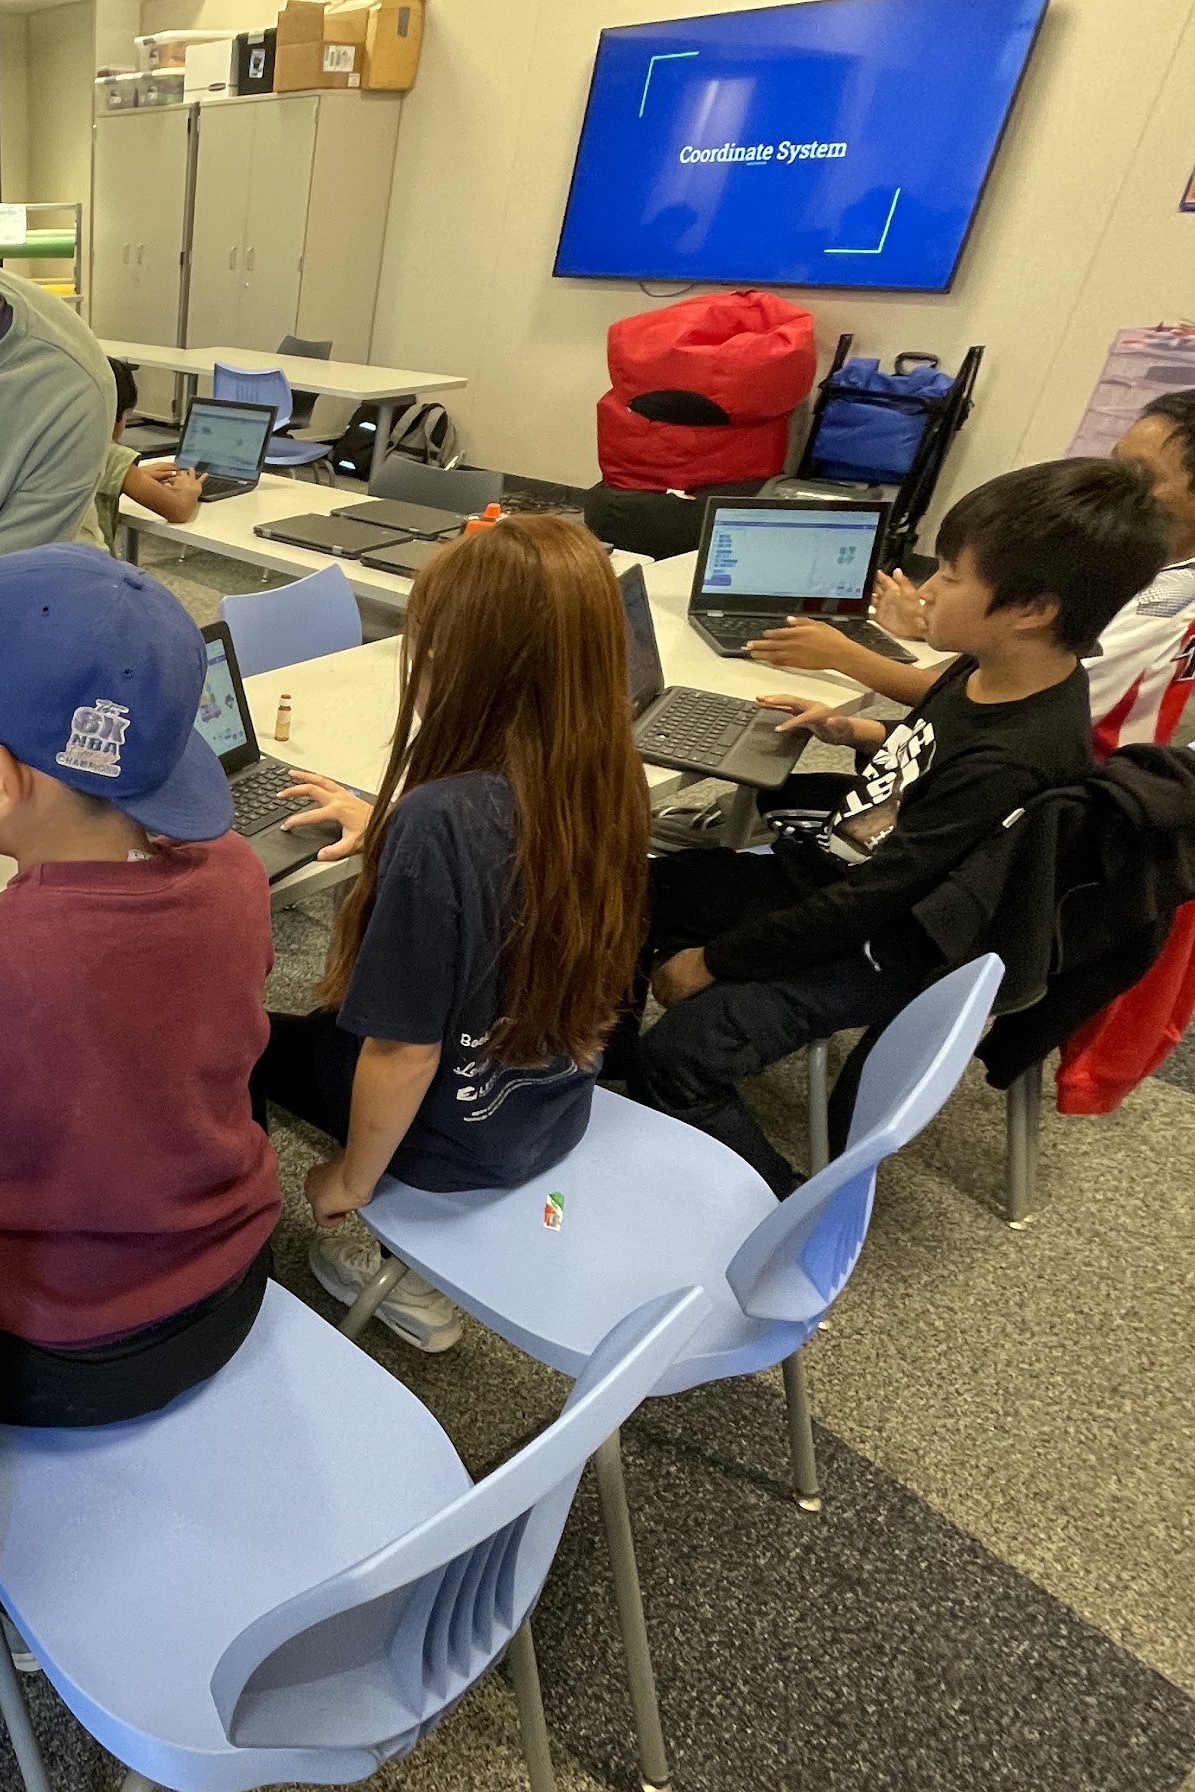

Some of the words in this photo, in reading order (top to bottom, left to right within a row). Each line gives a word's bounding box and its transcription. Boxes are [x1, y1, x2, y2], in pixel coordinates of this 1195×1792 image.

[679, 142, 774, 164] Coordinate
[775, 140, 849, 165] System
[71, 733, 117, 756] NBA
